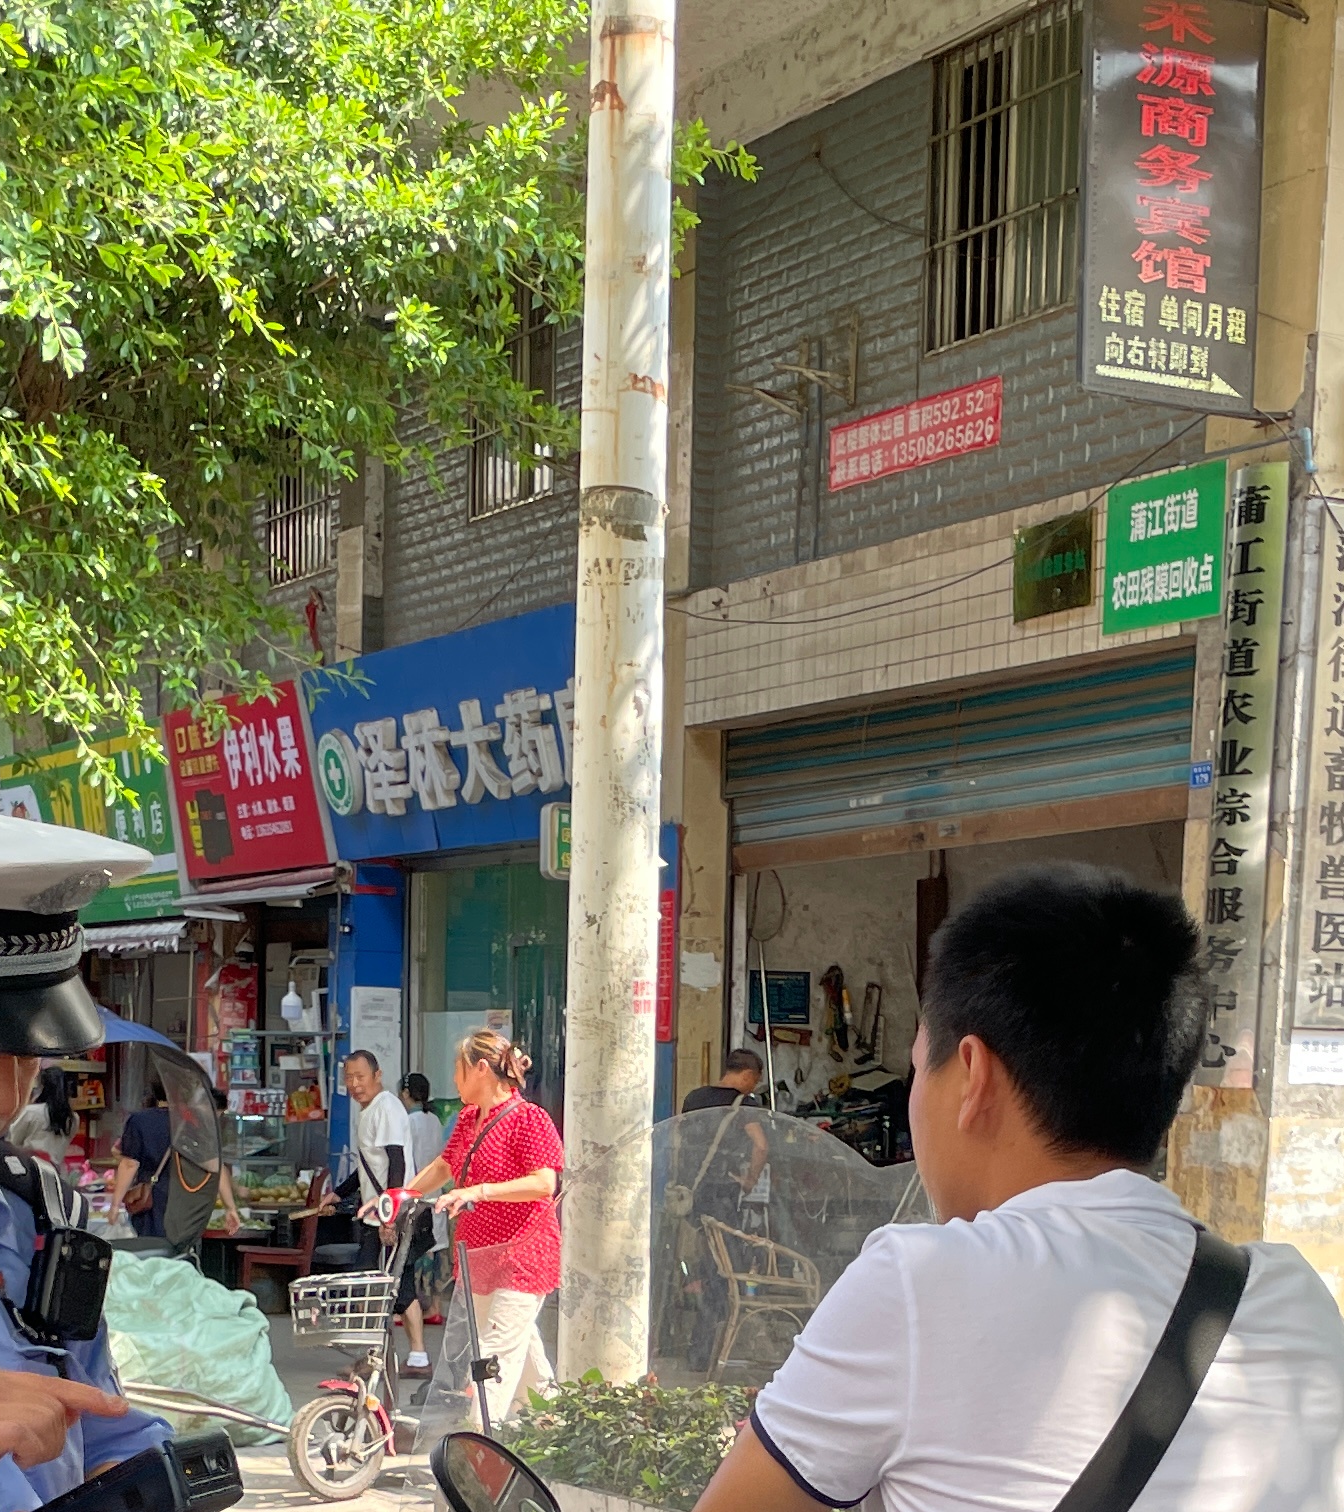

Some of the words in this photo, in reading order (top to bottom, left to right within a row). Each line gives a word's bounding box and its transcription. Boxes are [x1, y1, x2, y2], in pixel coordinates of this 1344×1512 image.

[1098, 285, 1146, 327] 住宿
[1158, 294, 1246, 345] 单间月租
[1105, 332, 1209, 377] 向右转即到
[1129, 488, 1199, 542] 蒲江街道
[1112, 553, 1214, 610] 农田残膜回收点
[223, 715, 302, 790] 伊利水果
